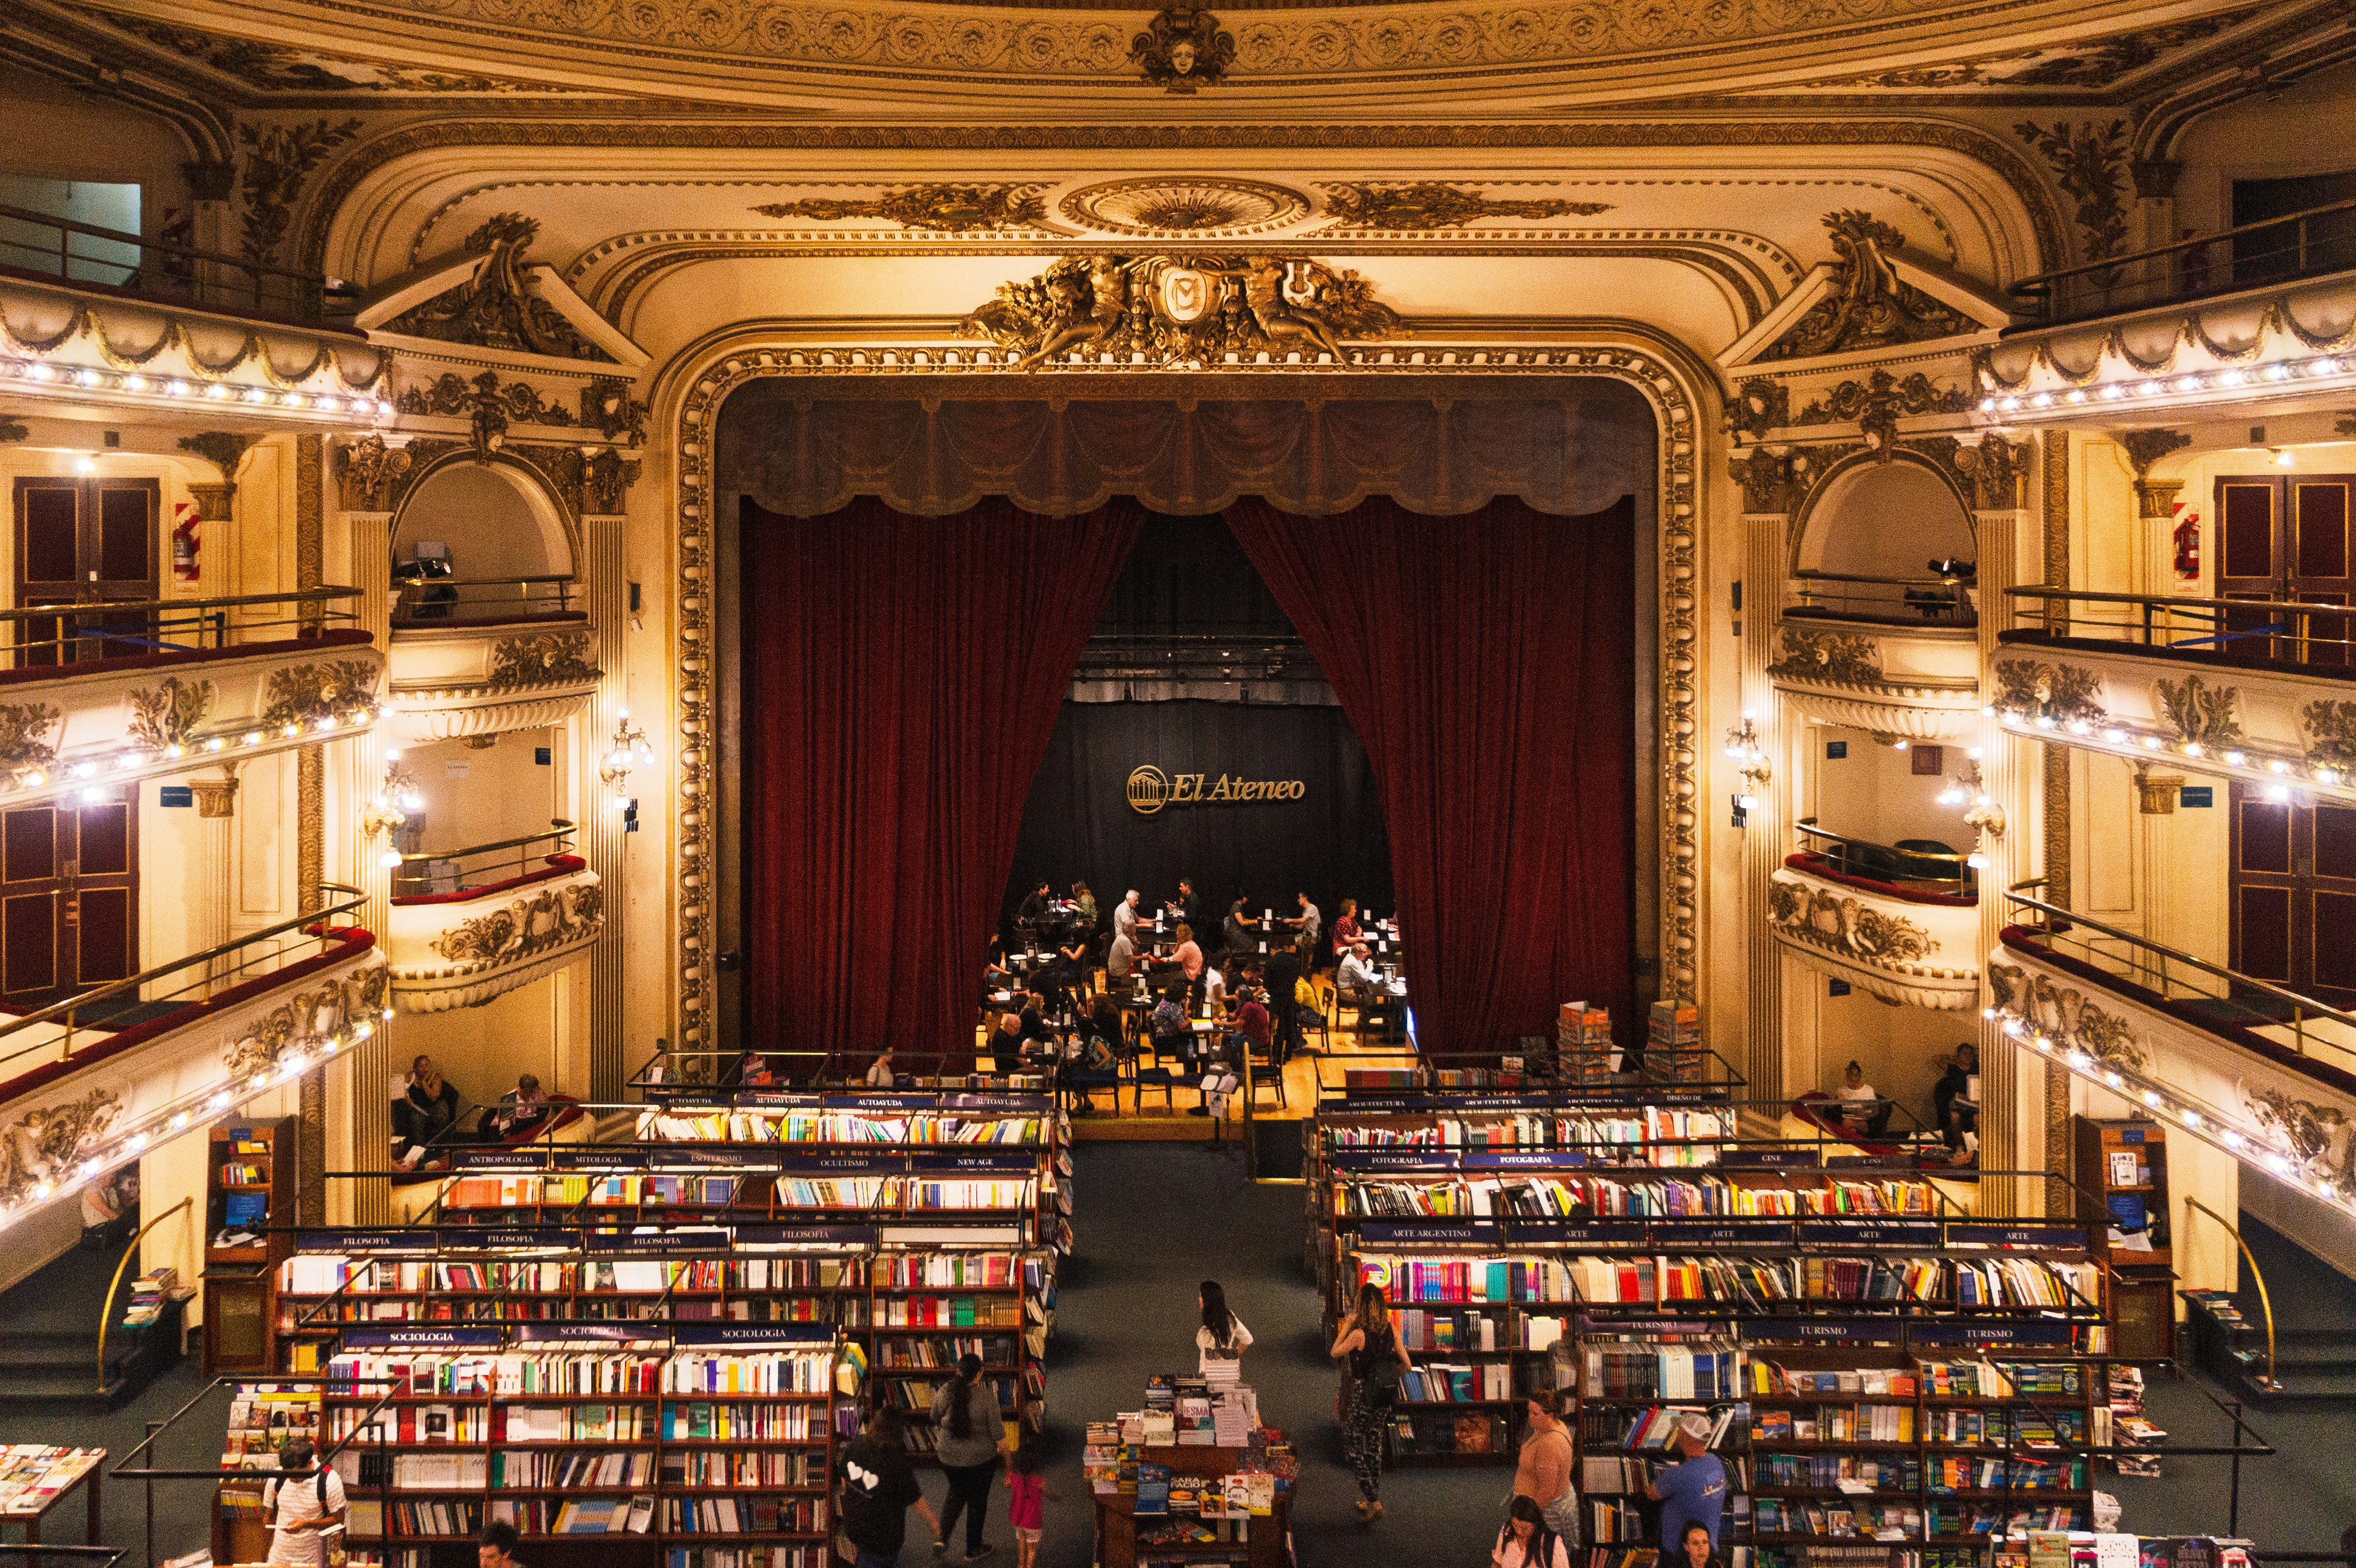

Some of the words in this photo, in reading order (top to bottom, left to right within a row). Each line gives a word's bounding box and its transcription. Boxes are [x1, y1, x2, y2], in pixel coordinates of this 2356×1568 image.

[1169, 774, 1204, 801] El
[1207, 773, 1305, 801] Ateneo
[857, 1098, 903, 1107] AUTOAYUDA
[783, 1230, 830, 1239] FILOSOFIA
[560, 1326, 624, 1335] SOCIOLOGIA
[722, 1329, 786, 1338] SOCIOLOGIA
[1799, 1326, 1847, 1335] TURISMO
[1964, 1330, 2013, 1338] TURISMO
[390, 1333, 454, 1341] SOCIOLOGIA
